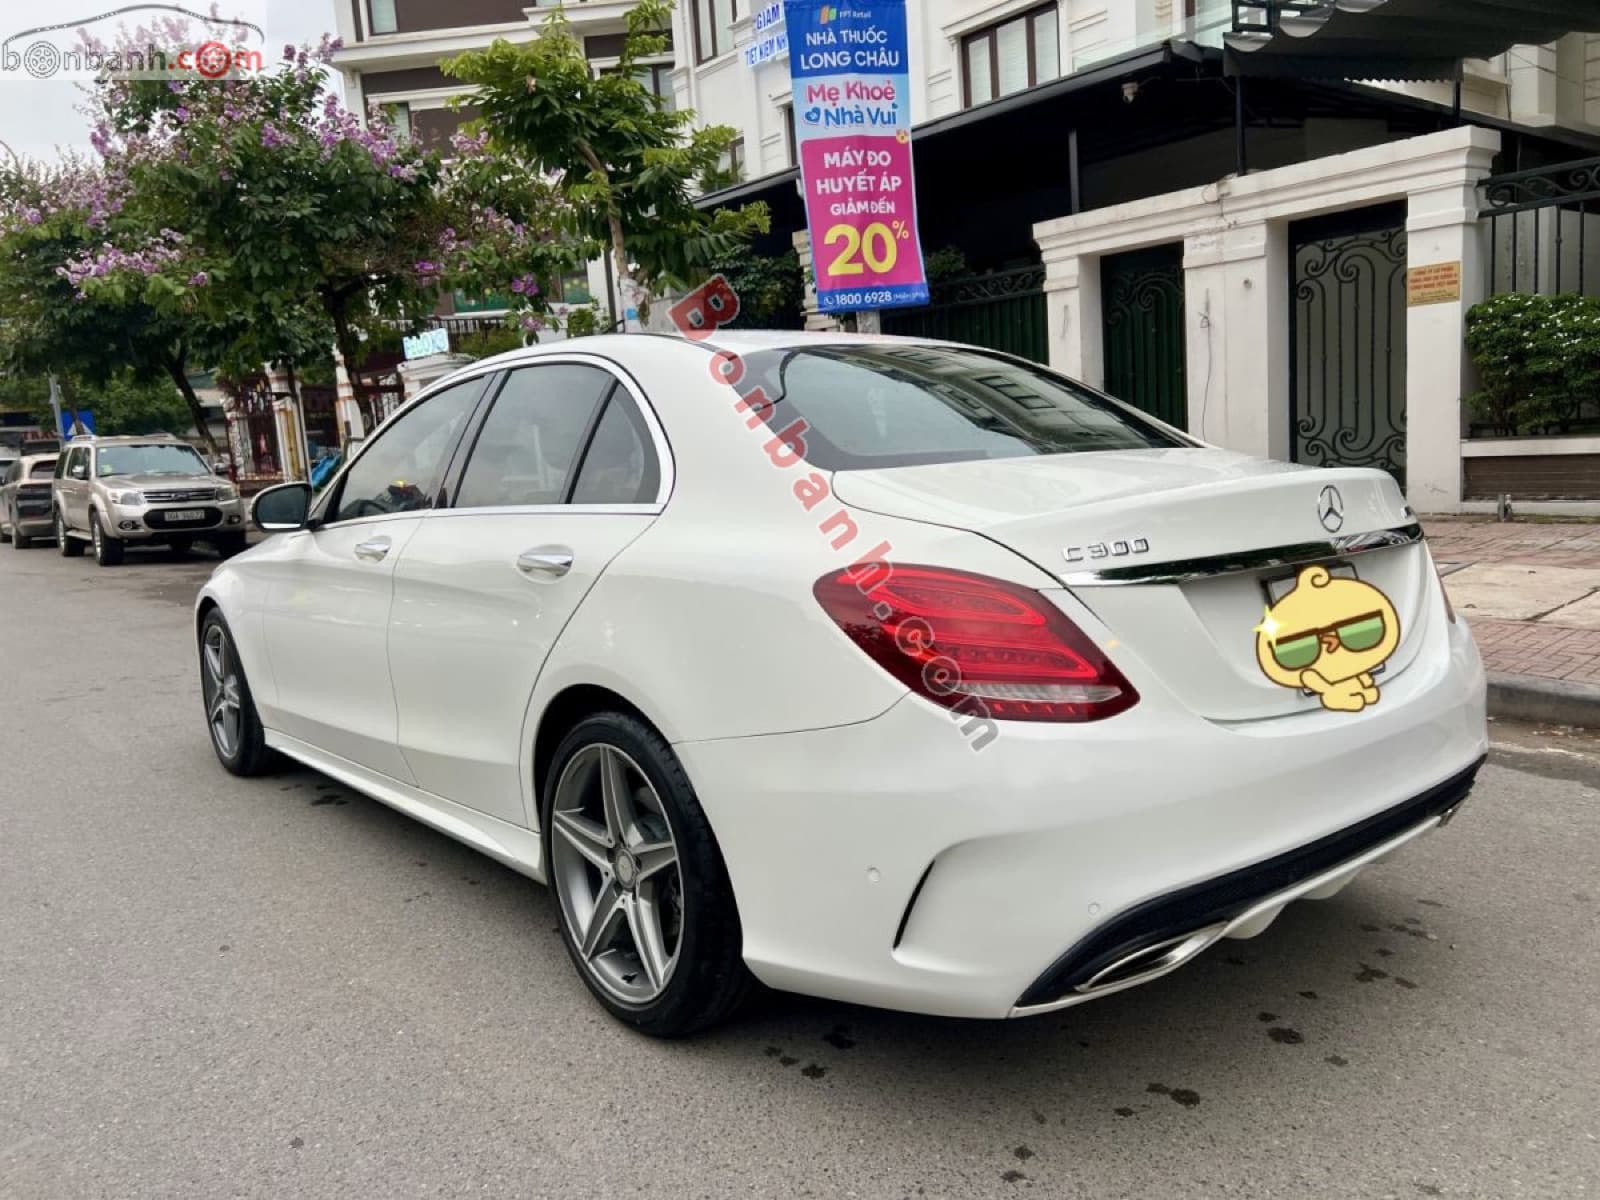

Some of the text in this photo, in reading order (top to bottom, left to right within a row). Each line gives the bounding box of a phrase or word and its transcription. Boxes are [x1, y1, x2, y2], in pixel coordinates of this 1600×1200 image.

[805, 24, 888, 46] NHÀ THUỐC
[800, 46, 899, 70] LONG CHÂU
[806, 80, 895, 107] Mẹ Khoẻ
[824, 102, 898, 127] Nhà Vui
[823, 146, 892, 168] MÁY ĐO
[816, 168, 902, 195] HUYẾT ÁP
[830, 196, 896, 216] GIẢM ĐẾN
[836, 293, 862, 306] 1800
[864, 290, 892, 304] 6928
